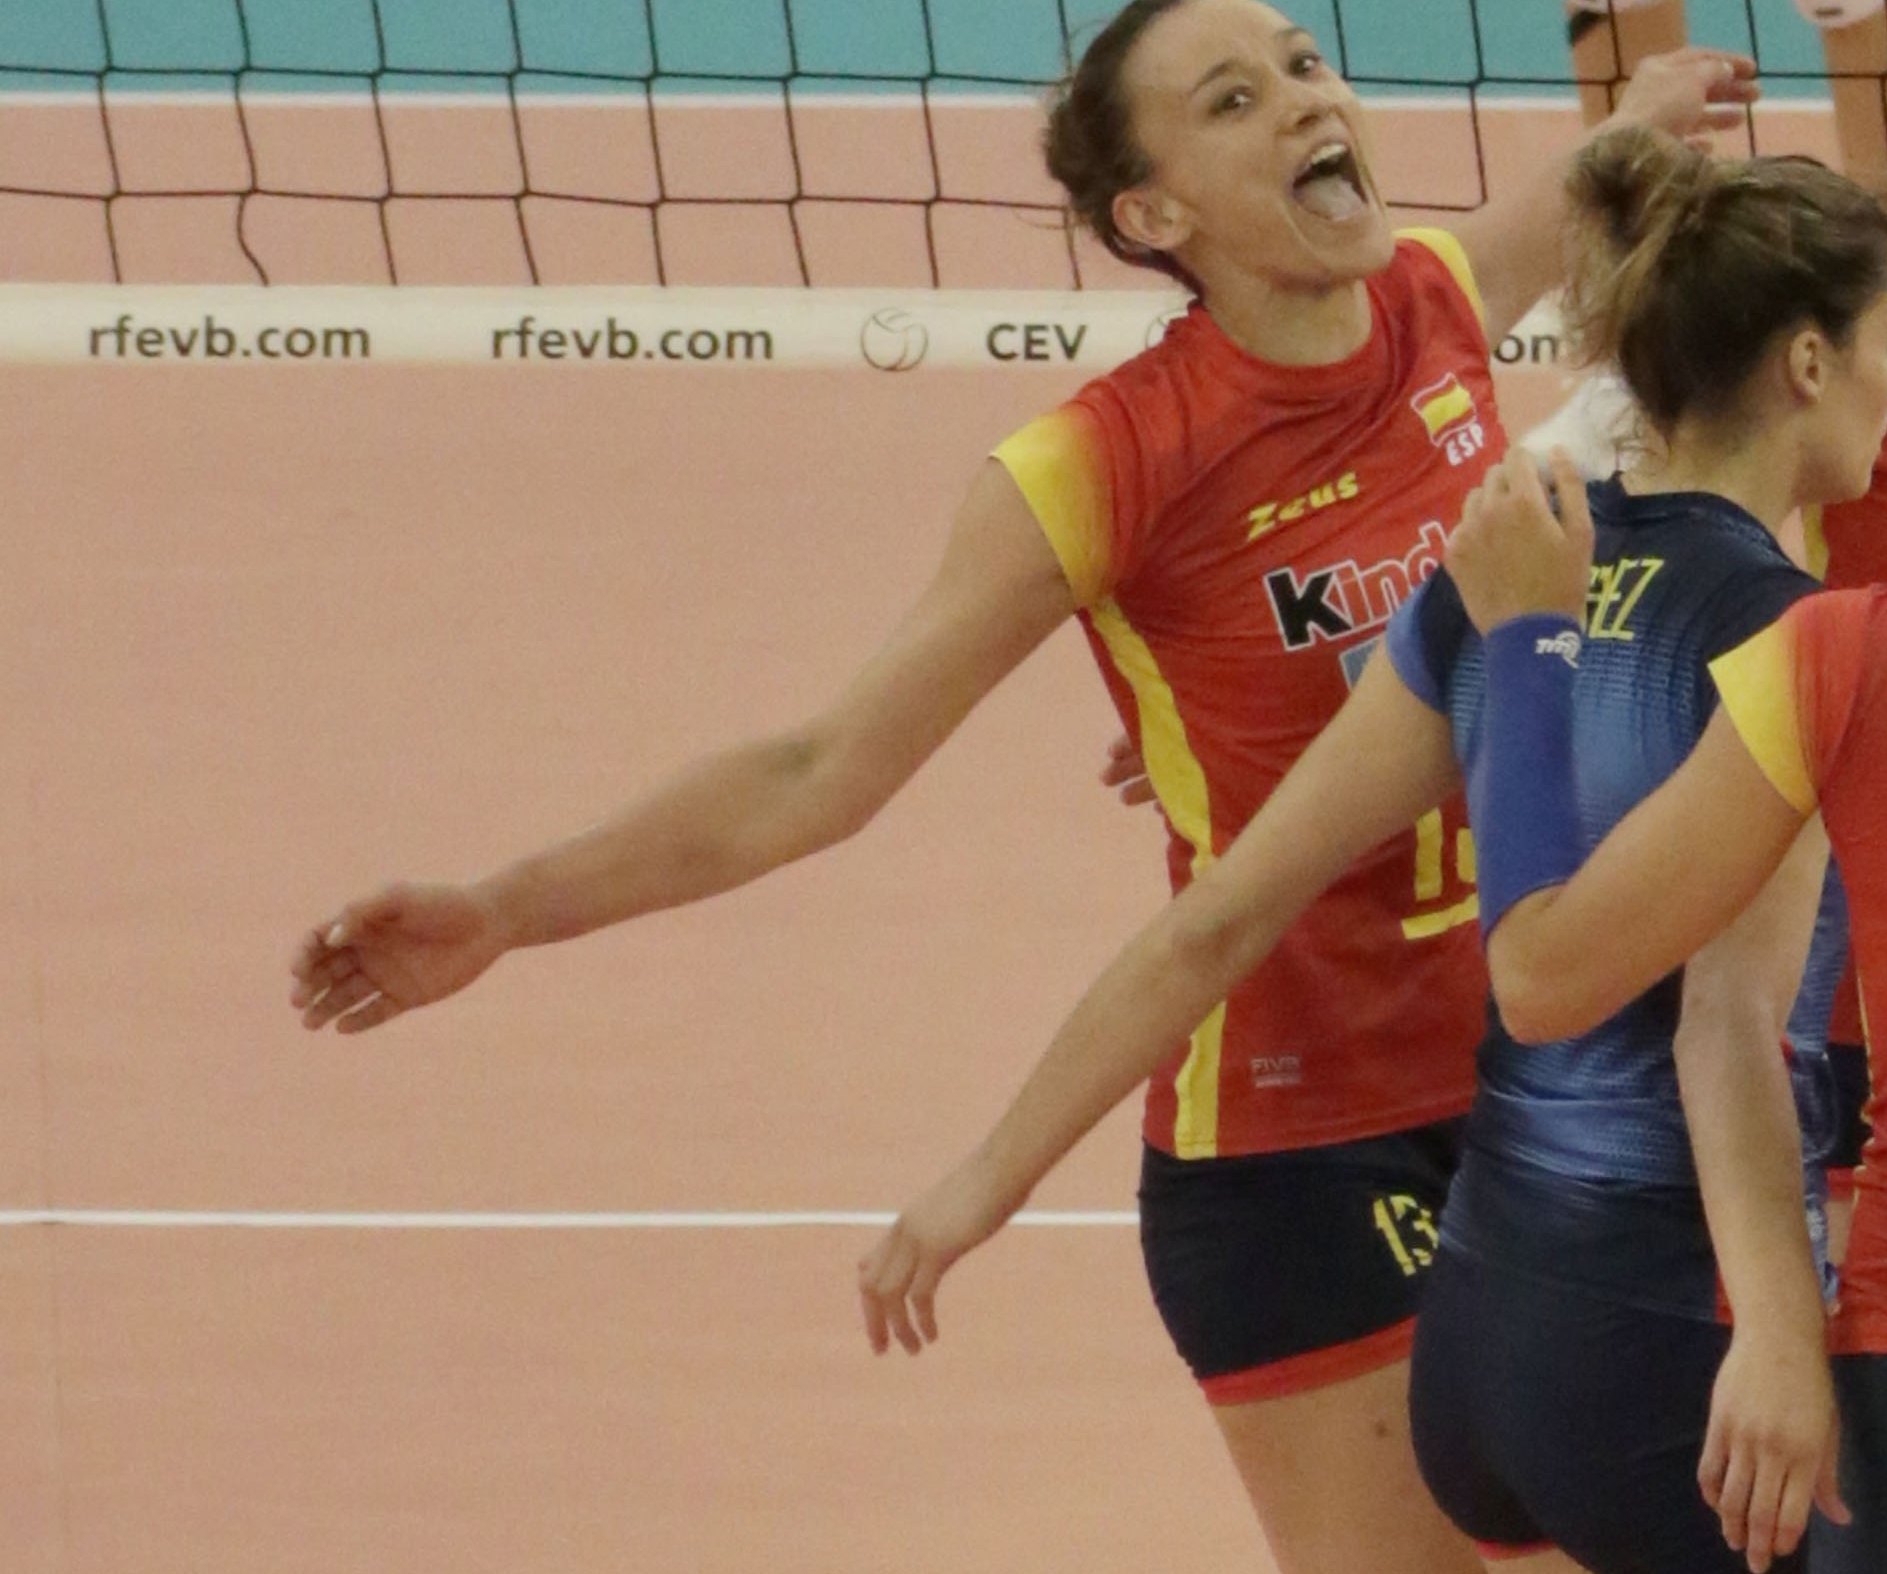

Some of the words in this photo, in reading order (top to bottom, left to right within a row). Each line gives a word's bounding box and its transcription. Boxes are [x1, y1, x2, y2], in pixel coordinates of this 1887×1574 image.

[88, 313, 371, 360] rfevb.com
[491, 315, 774, 362] rfevb.com
[985, 322, 1087, 363] CEV
[1444, 422, 1486, 467] ESP
[1373, 1194, 1440, 1277] 13
